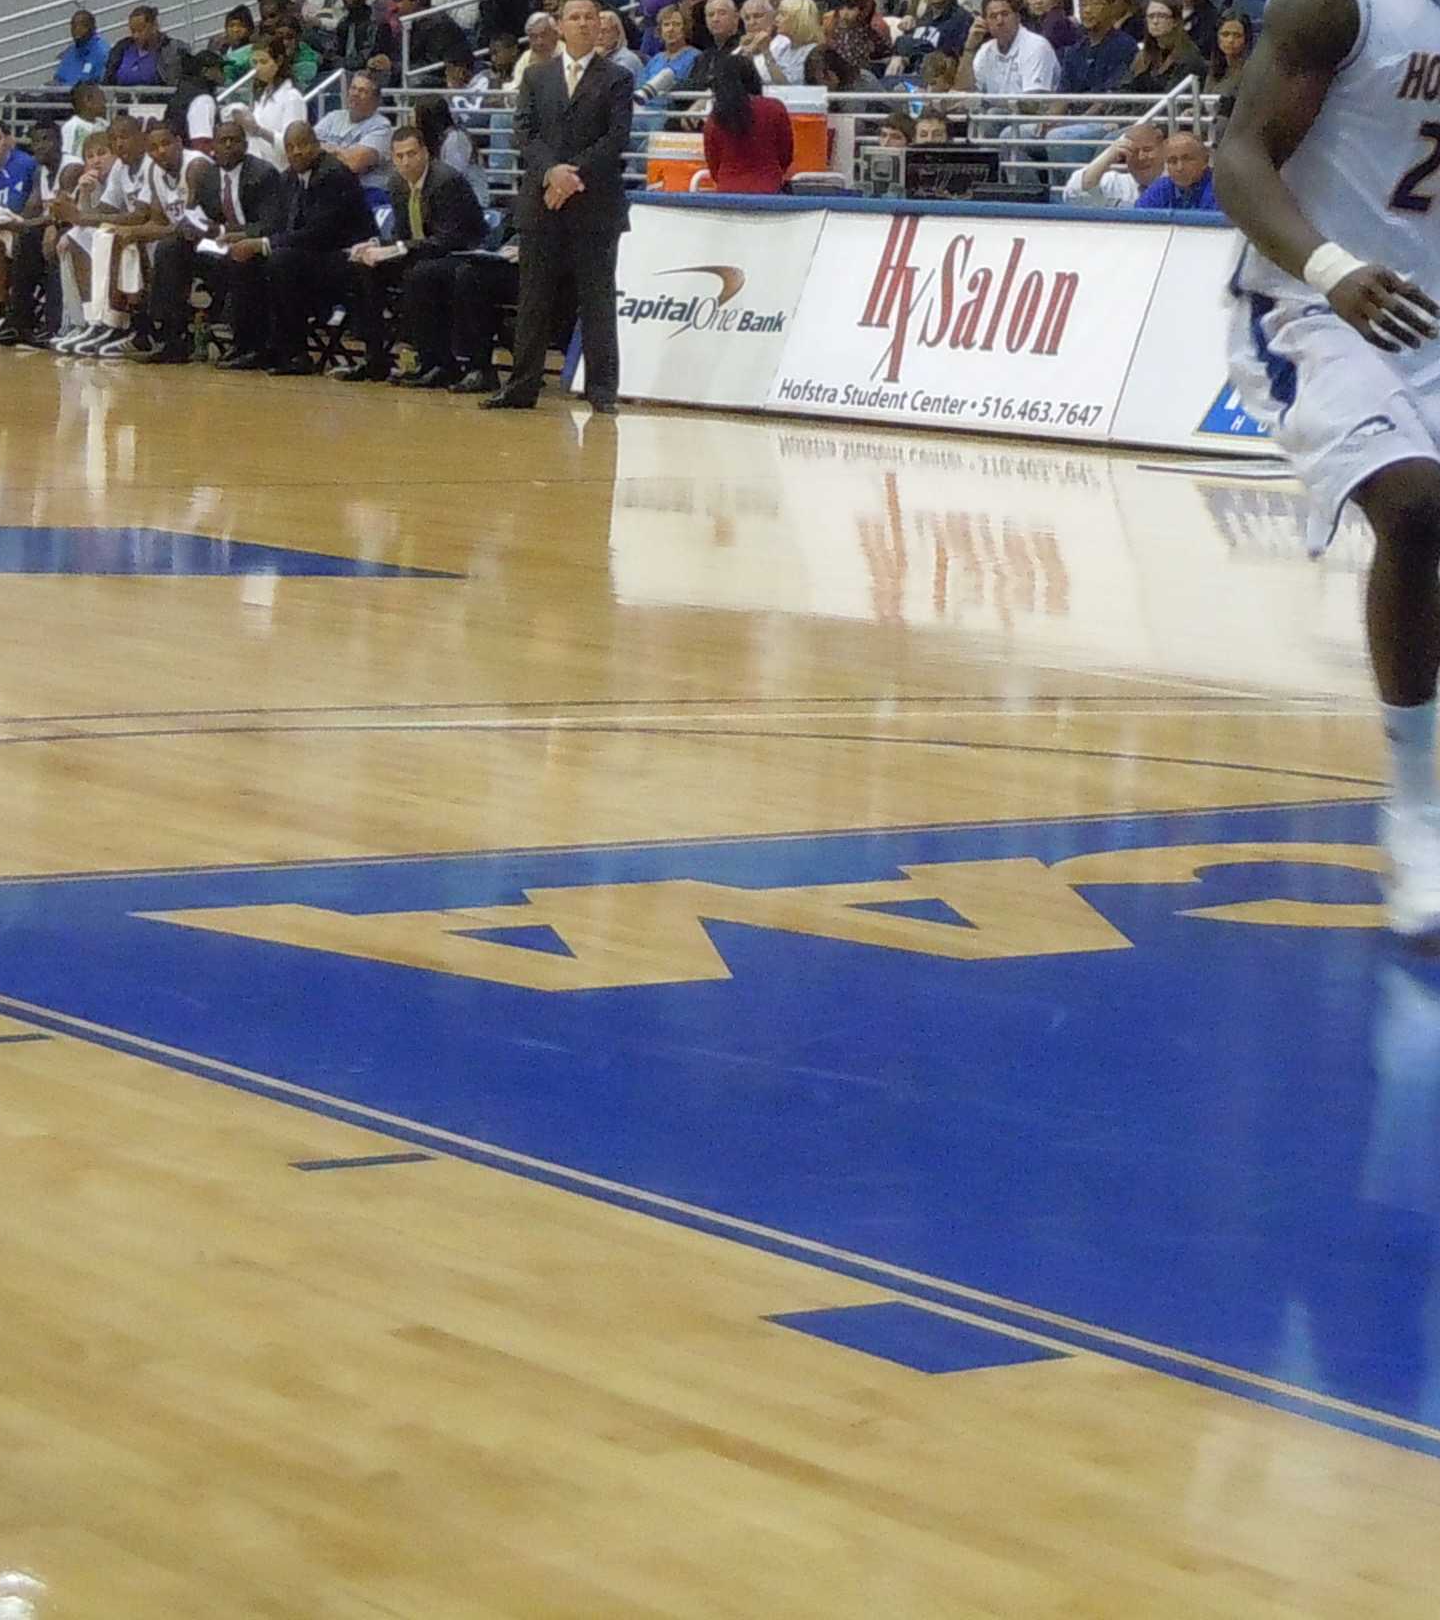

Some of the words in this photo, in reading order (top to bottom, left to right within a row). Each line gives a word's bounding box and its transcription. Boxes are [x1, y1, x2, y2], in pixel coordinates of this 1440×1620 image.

[736, 310, 787, 333] Bank
[777, 378, 838, 406] Hofstra
[840, 383, 908, 412] Student
[910, 390, 968, 416] Center
[978, 396, 1103, 427] 516.463.7647
